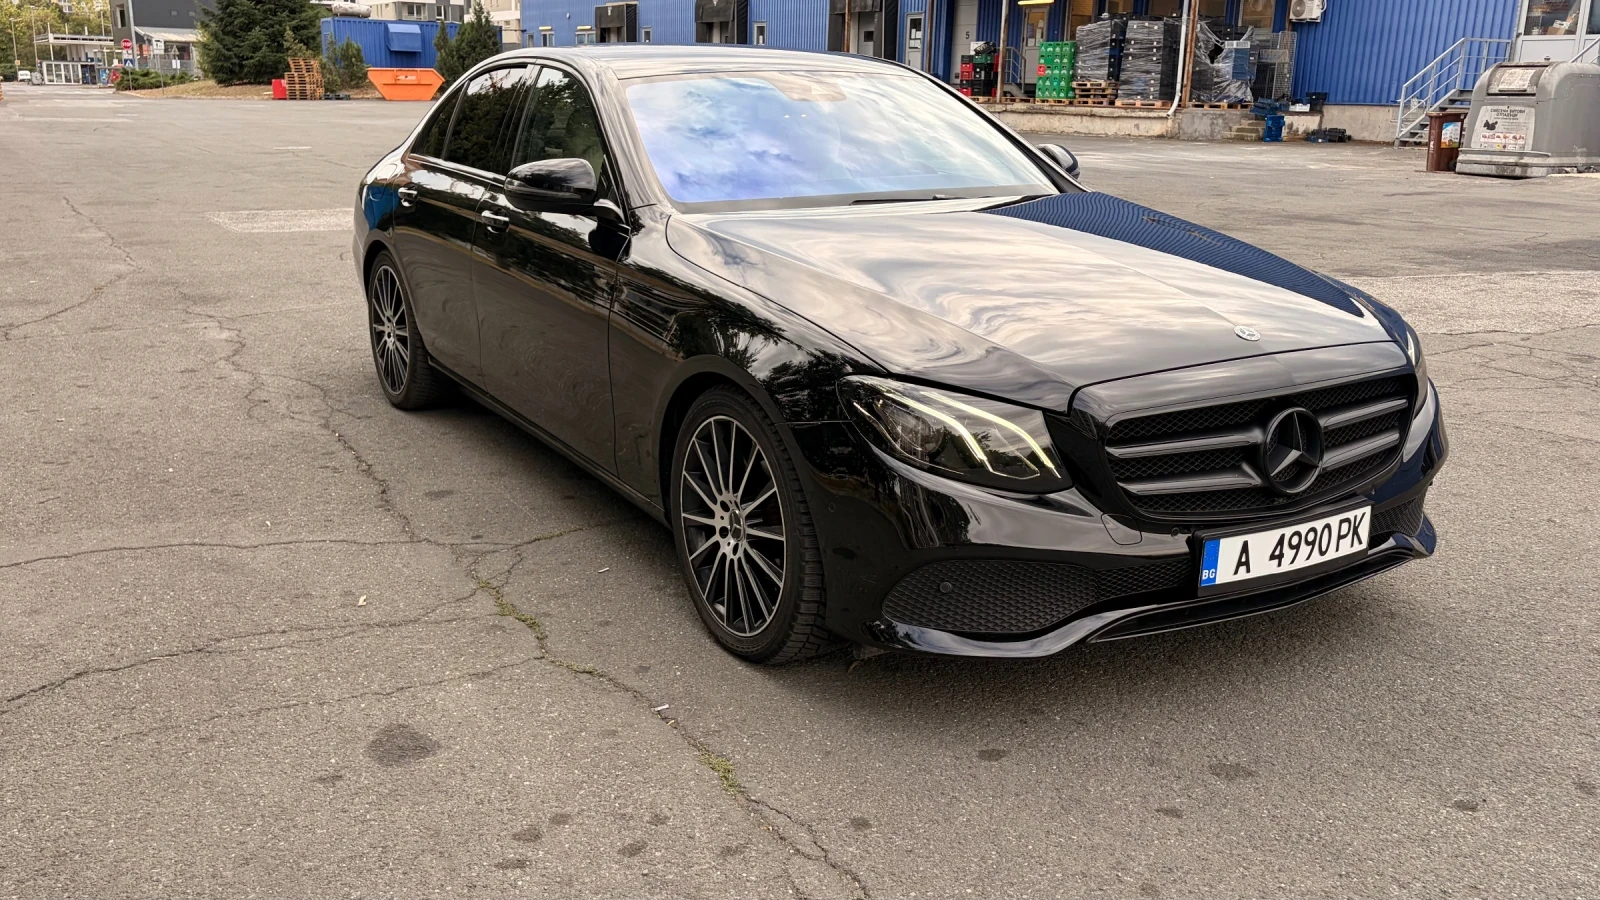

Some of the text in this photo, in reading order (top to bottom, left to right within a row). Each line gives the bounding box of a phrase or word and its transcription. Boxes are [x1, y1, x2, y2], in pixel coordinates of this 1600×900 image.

[965, 31, 970, 39] 5
[1233, 540, 1251, 575] A
[1268, 522, 1332, 567] 4990
[1202, 568, 1216, 580] BG
